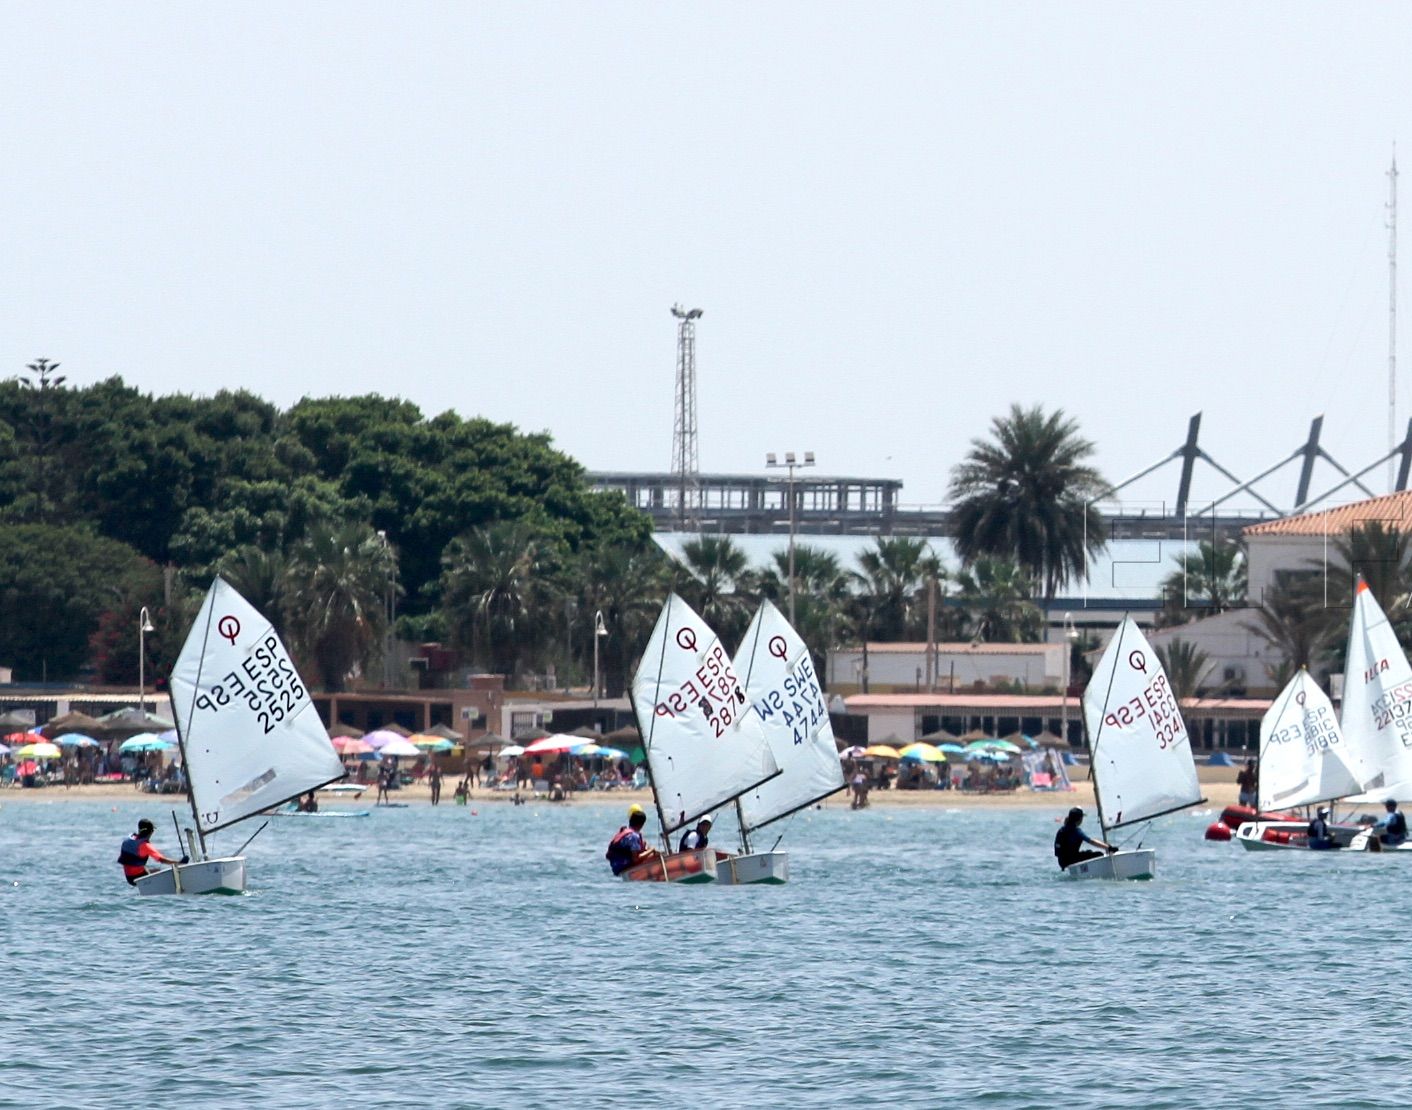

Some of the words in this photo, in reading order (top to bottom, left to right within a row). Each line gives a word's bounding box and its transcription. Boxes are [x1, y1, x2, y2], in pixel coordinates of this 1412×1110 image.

[242, 637, 278, 680] ESP
[696, 646, 725, 688] ESP
[783, 657, 813, 698] SWE
[1364, 658, 1390, 684] ILCA
[257, 678, 304, 734] 2525
[1144, 675, 1167, 707] ESP
[793, 704, 825, 746] 4744
[1156, 717, 1183, 749] 3341
